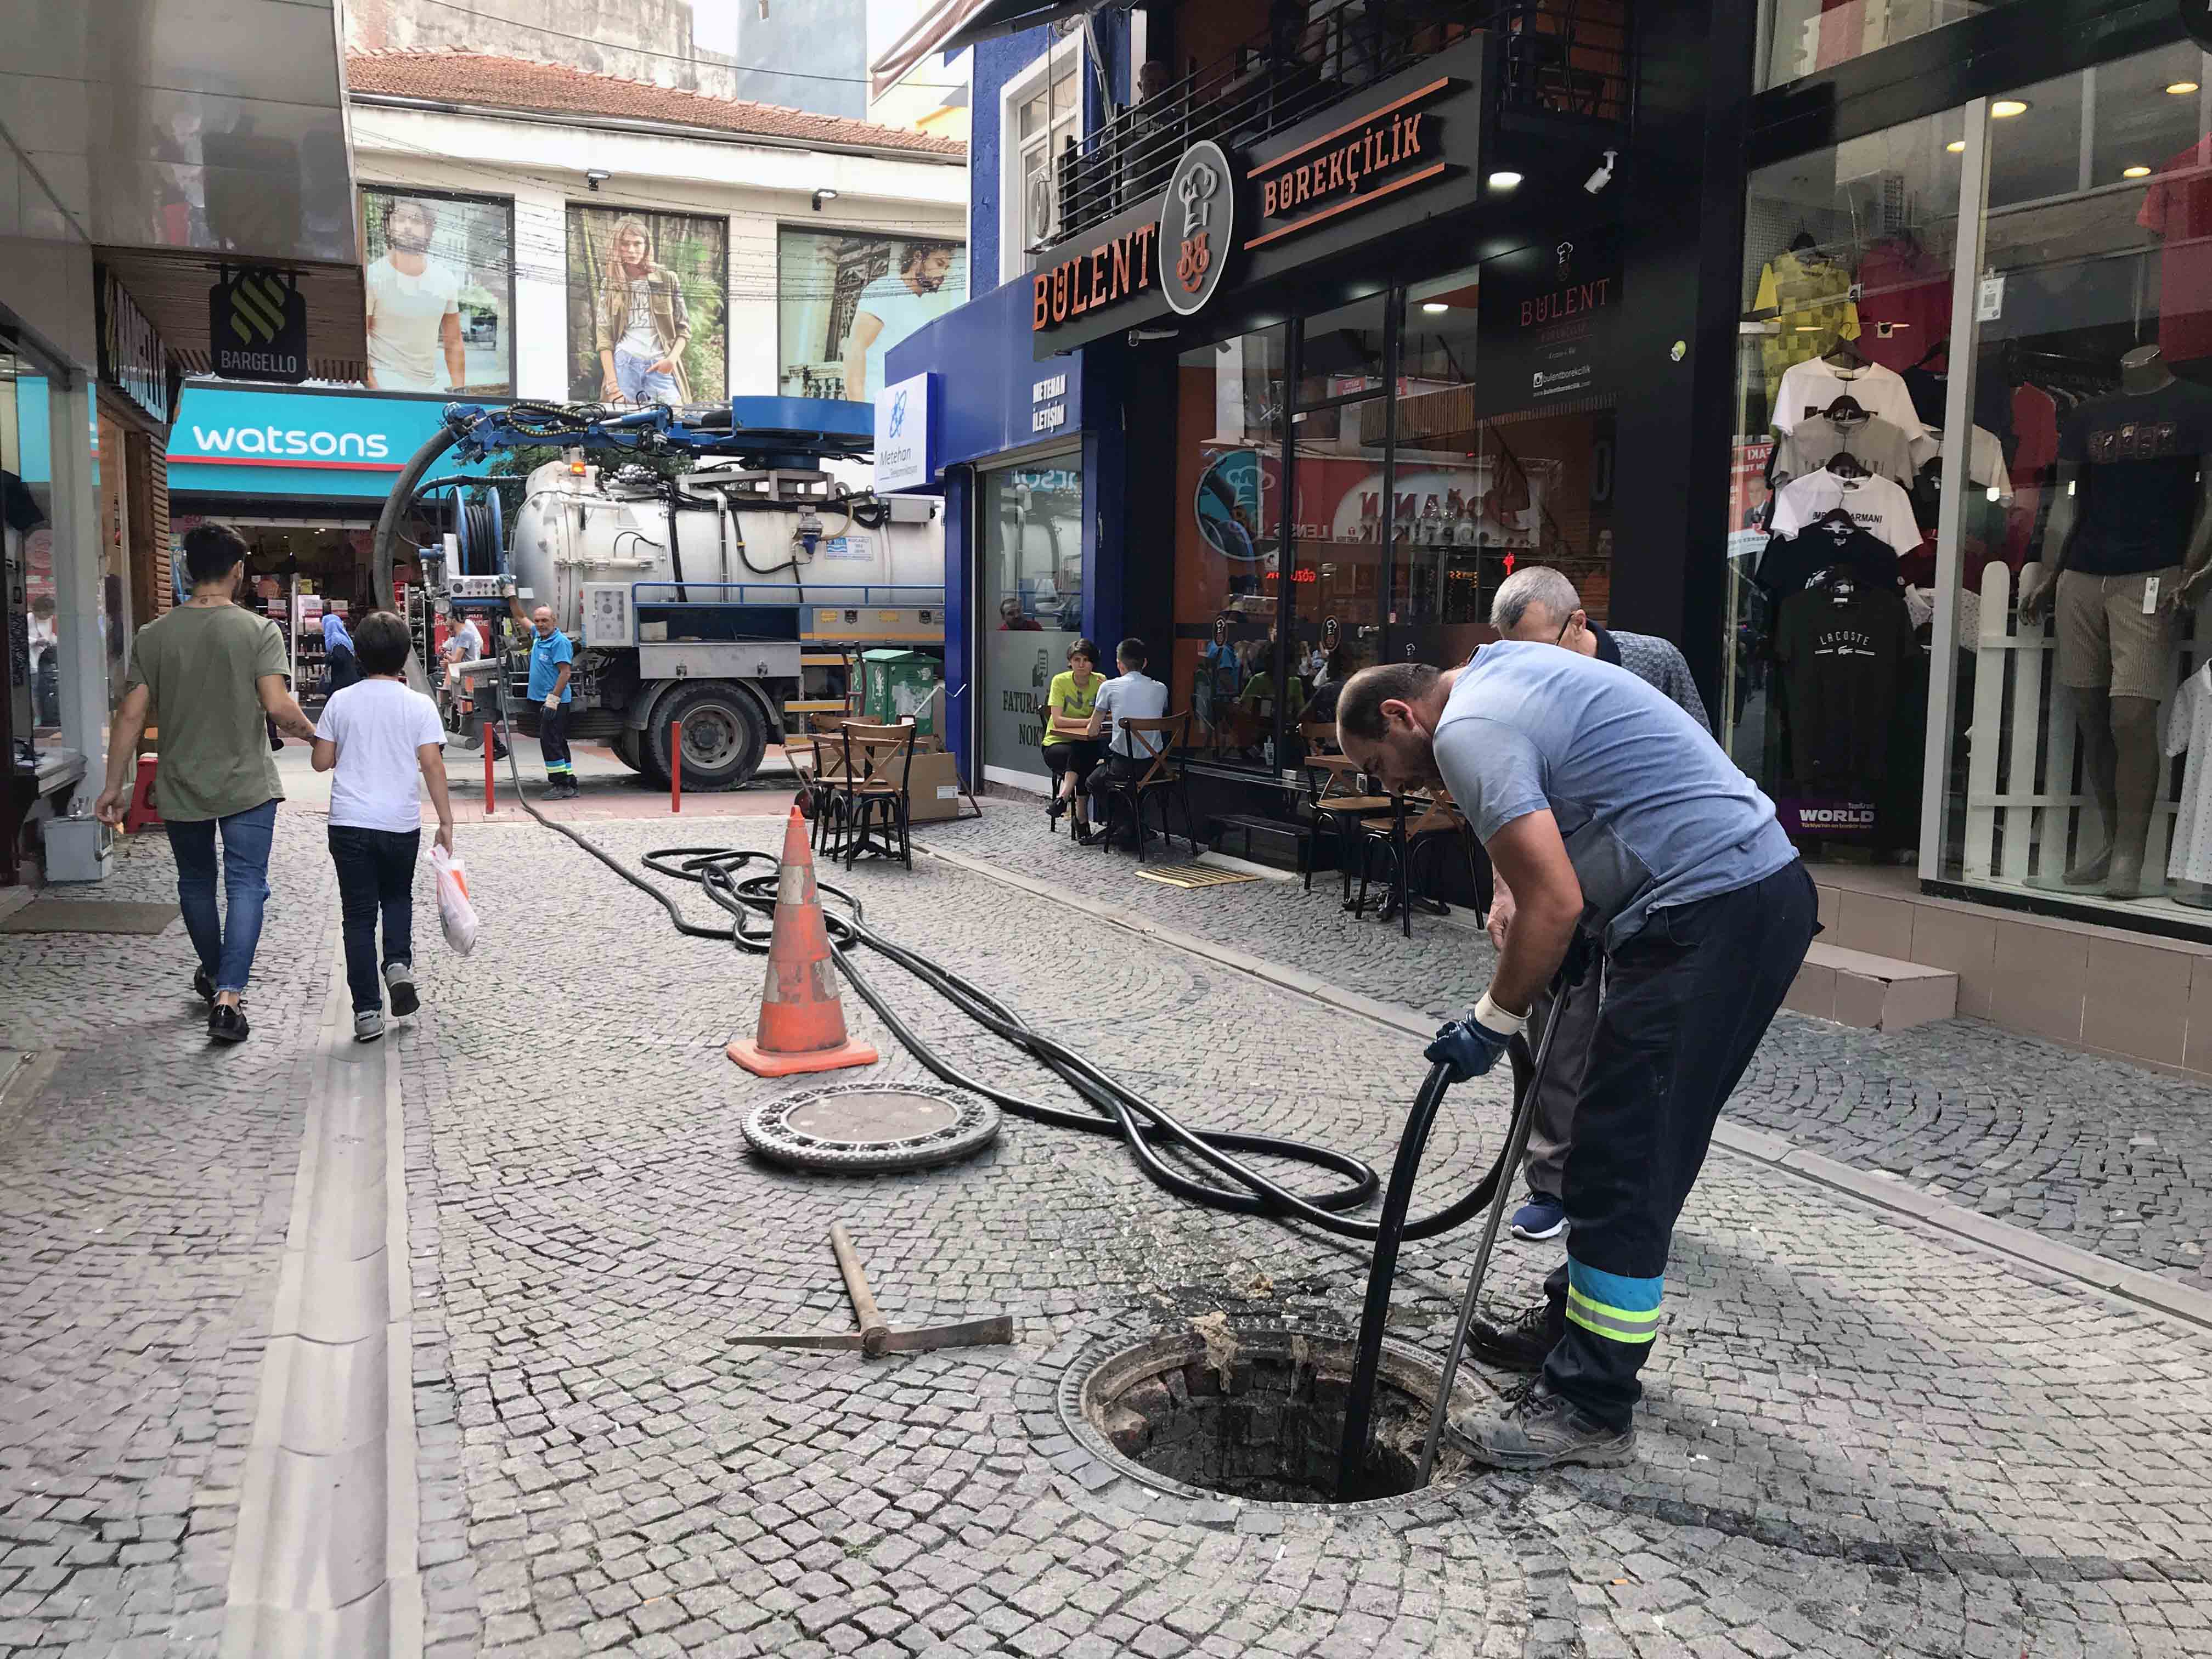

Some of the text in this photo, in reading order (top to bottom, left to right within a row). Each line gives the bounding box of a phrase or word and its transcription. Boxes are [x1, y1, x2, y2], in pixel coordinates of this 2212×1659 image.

[1033, 222, 1155, 331] BÜLENT
[221, 349, 297, 373] BARGELLO
[1032, 374, 1066, 404] METEHAN
[1032, 400, 1065, 433] İLETİŞİM
[193, 425, 389, 458] watsons
[879, 446, 912, 466] Metehan
[1850, 512, 1883, 523] ARMANI
[1819, 630, 1870, 646] LACOSTE
[1003, 690, 1039, 714] FATURA
[1799, 809, 1875, 822] WORLD
